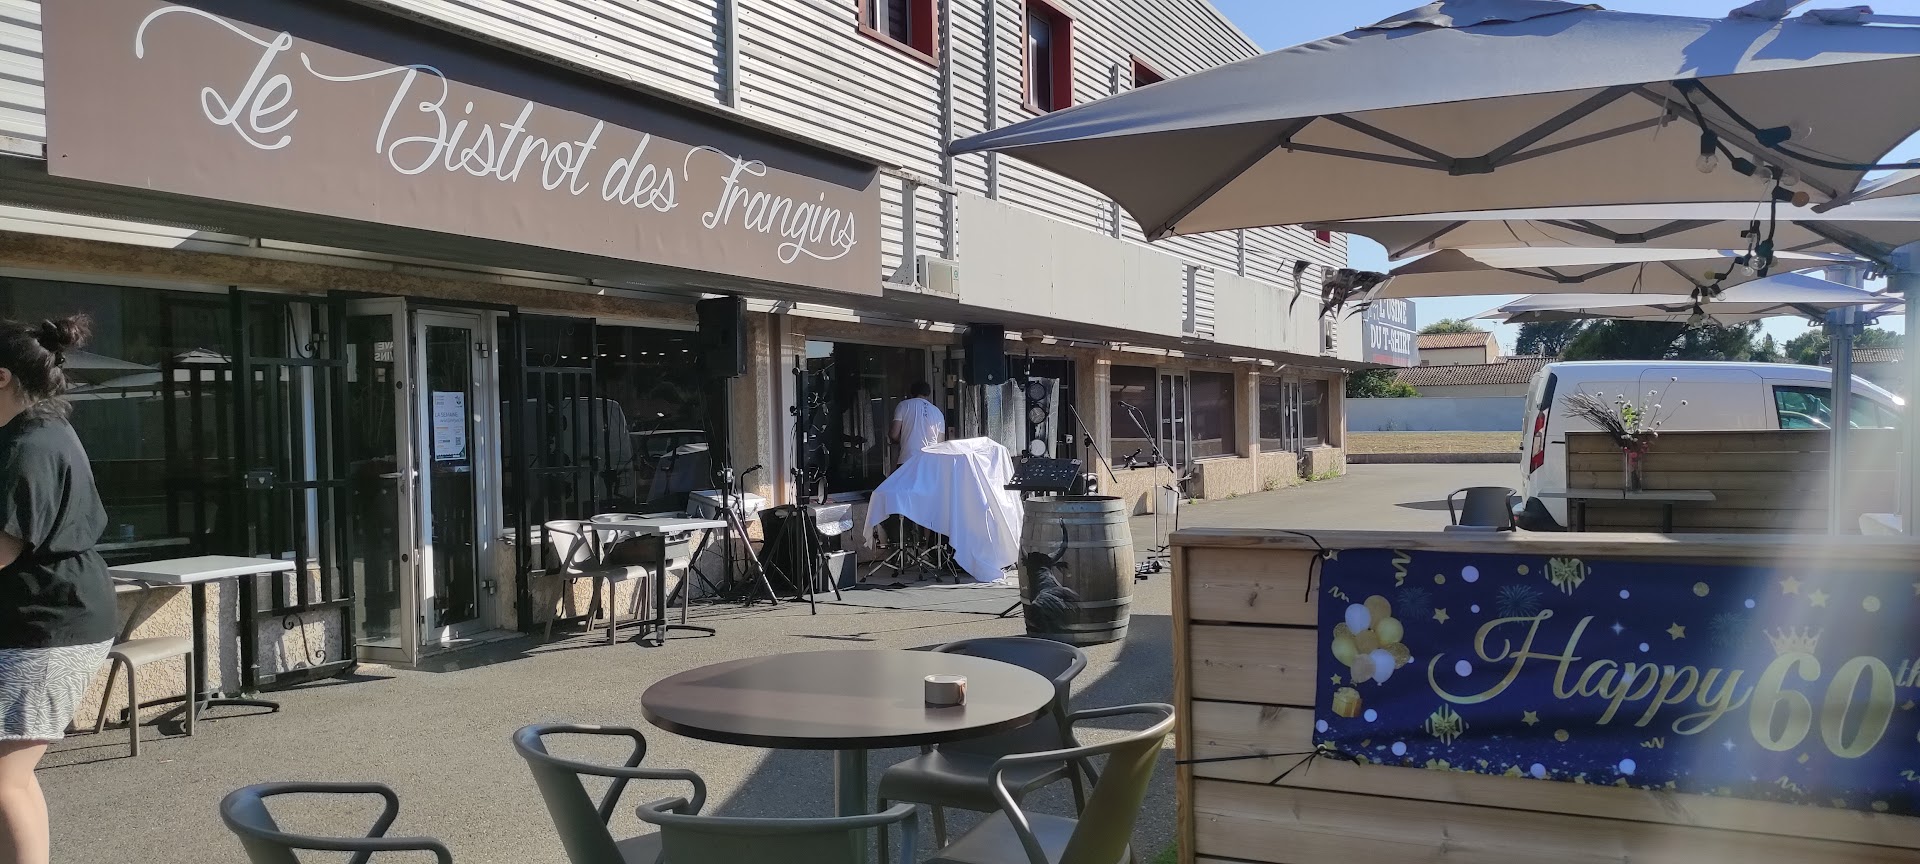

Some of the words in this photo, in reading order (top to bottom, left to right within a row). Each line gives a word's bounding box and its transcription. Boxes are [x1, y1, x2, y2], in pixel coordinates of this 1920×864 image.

[136, 6, 298, 150] Le
[301, 53, 604, 196] Bistrot
[602, 133, 679, 213] des
[683, 145, 857, 264] Frangins
[1370, 323, 1382, 350] DU
[1382, 326, 1411, 355] T-SHIRT
[1427, 608, 1754, 735] Happy
